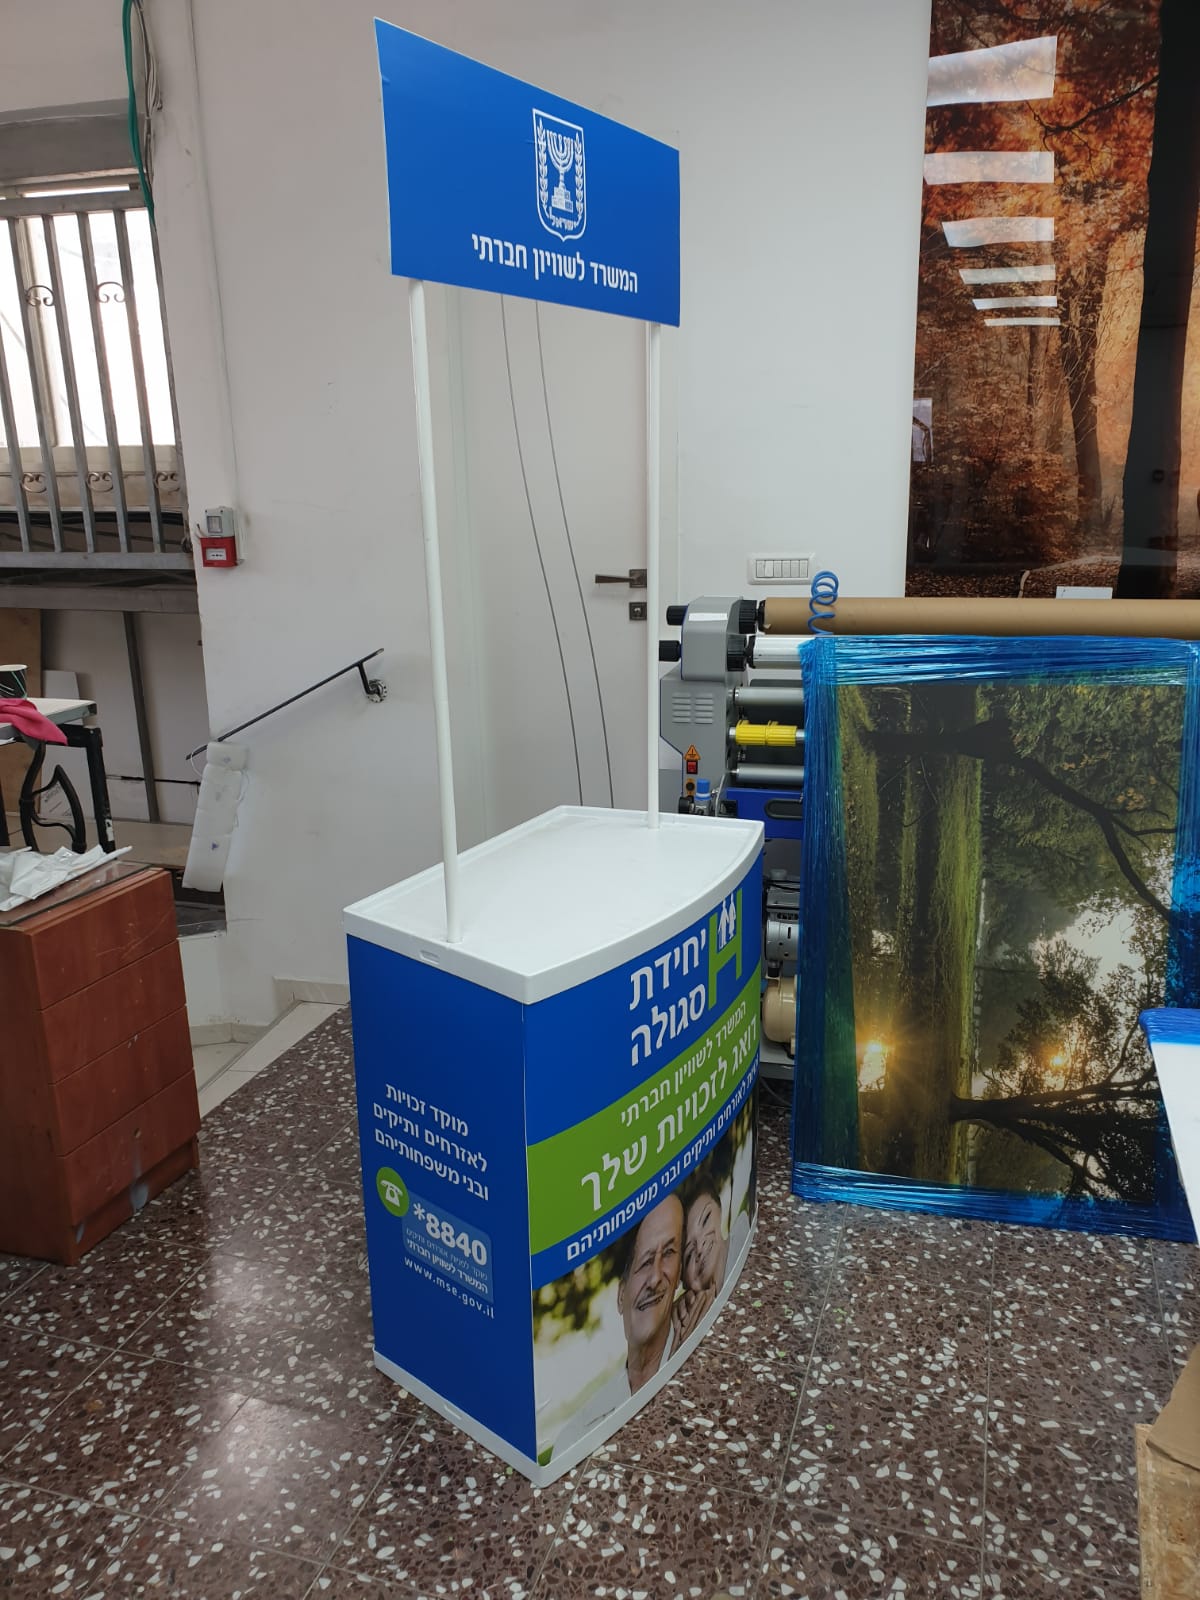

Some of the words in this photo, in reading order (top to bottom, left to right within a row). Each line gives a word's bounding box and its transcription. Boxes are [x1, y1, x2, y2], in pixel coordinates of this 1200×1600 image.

[472, 233, 528, 270] חברתי
[532, 248, 585, 281] לשוויון
[590, 261, 638, 293] המשרד
[630, 928, 706, 1011] יחידת
[632, 984, 706, 1067] סגולה
[716, 1001, 746, 1047] המשרד
[732, 1014, 757, 1075] דואג
[675, 1038, 713, 1094] לשוויון
[374, 1102, 419, 1138] ותיקים
[386, 1084, 426, 1115] זכויות
[430, 1105, 468, 1136] מוקד
[621, 1079, 670, 1127] חברתי
[656, 1056, 728, 1154] לזכויות
[718, 1082, 746, 1132] לאזרחים
[375, 1128, 460, 1185] משפחותיהם
[424, 1128, 487, 1172] לאזרחים
[684, 1126, 716, 1168] ותיקים
[462, 1175, 488, 1200] ובני
[581, 1135, 648, 1212] שלך
[660, 1160, 680, 1188] ובני
[566, 1182, 658, 1261] משפחותיהם
[404, 1256, 494, 1319] www.mse.gov.il
[457, 1269, 488, 1294] המשרד
